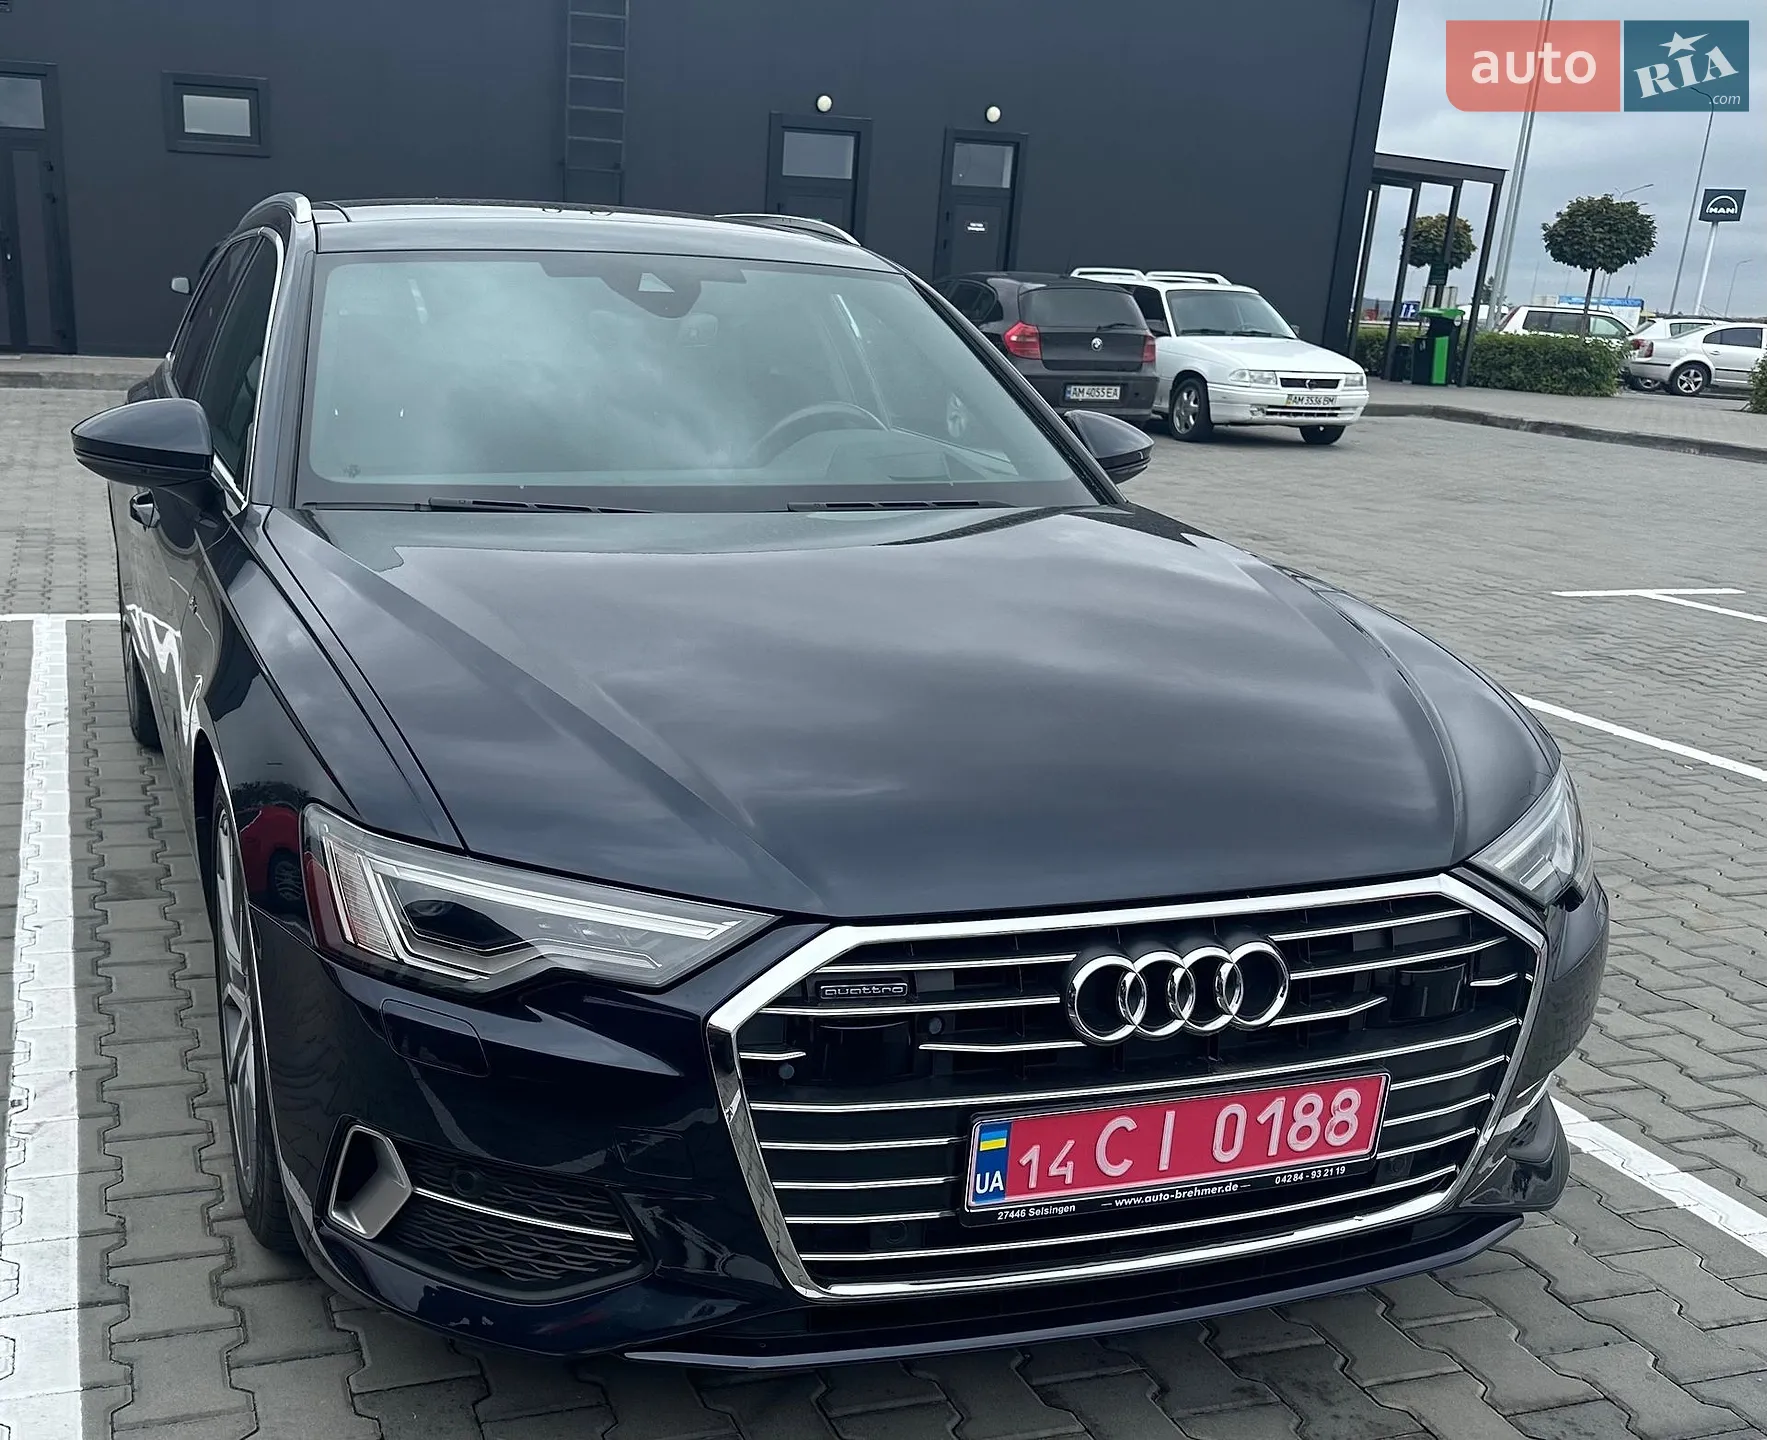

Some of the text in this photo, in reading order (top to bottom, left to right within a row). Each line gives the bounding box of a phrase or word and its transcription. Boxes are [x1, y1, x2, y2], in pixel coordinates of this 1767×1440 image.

[1072, 388, 1119, 398] AM 4055 EA
[824, 986, 904, 996] quattro
[1018, 1088, 1361, 1189] 14 CI 0188
[975, 1170, 1004, 1194] UA
[1274, 1172, 1304, 1185] 04284
[1114, 1181, 1239, 1207] www.auto-brehmer.de
[997, 1204, 1076, 1220] 27446 Selsingen
